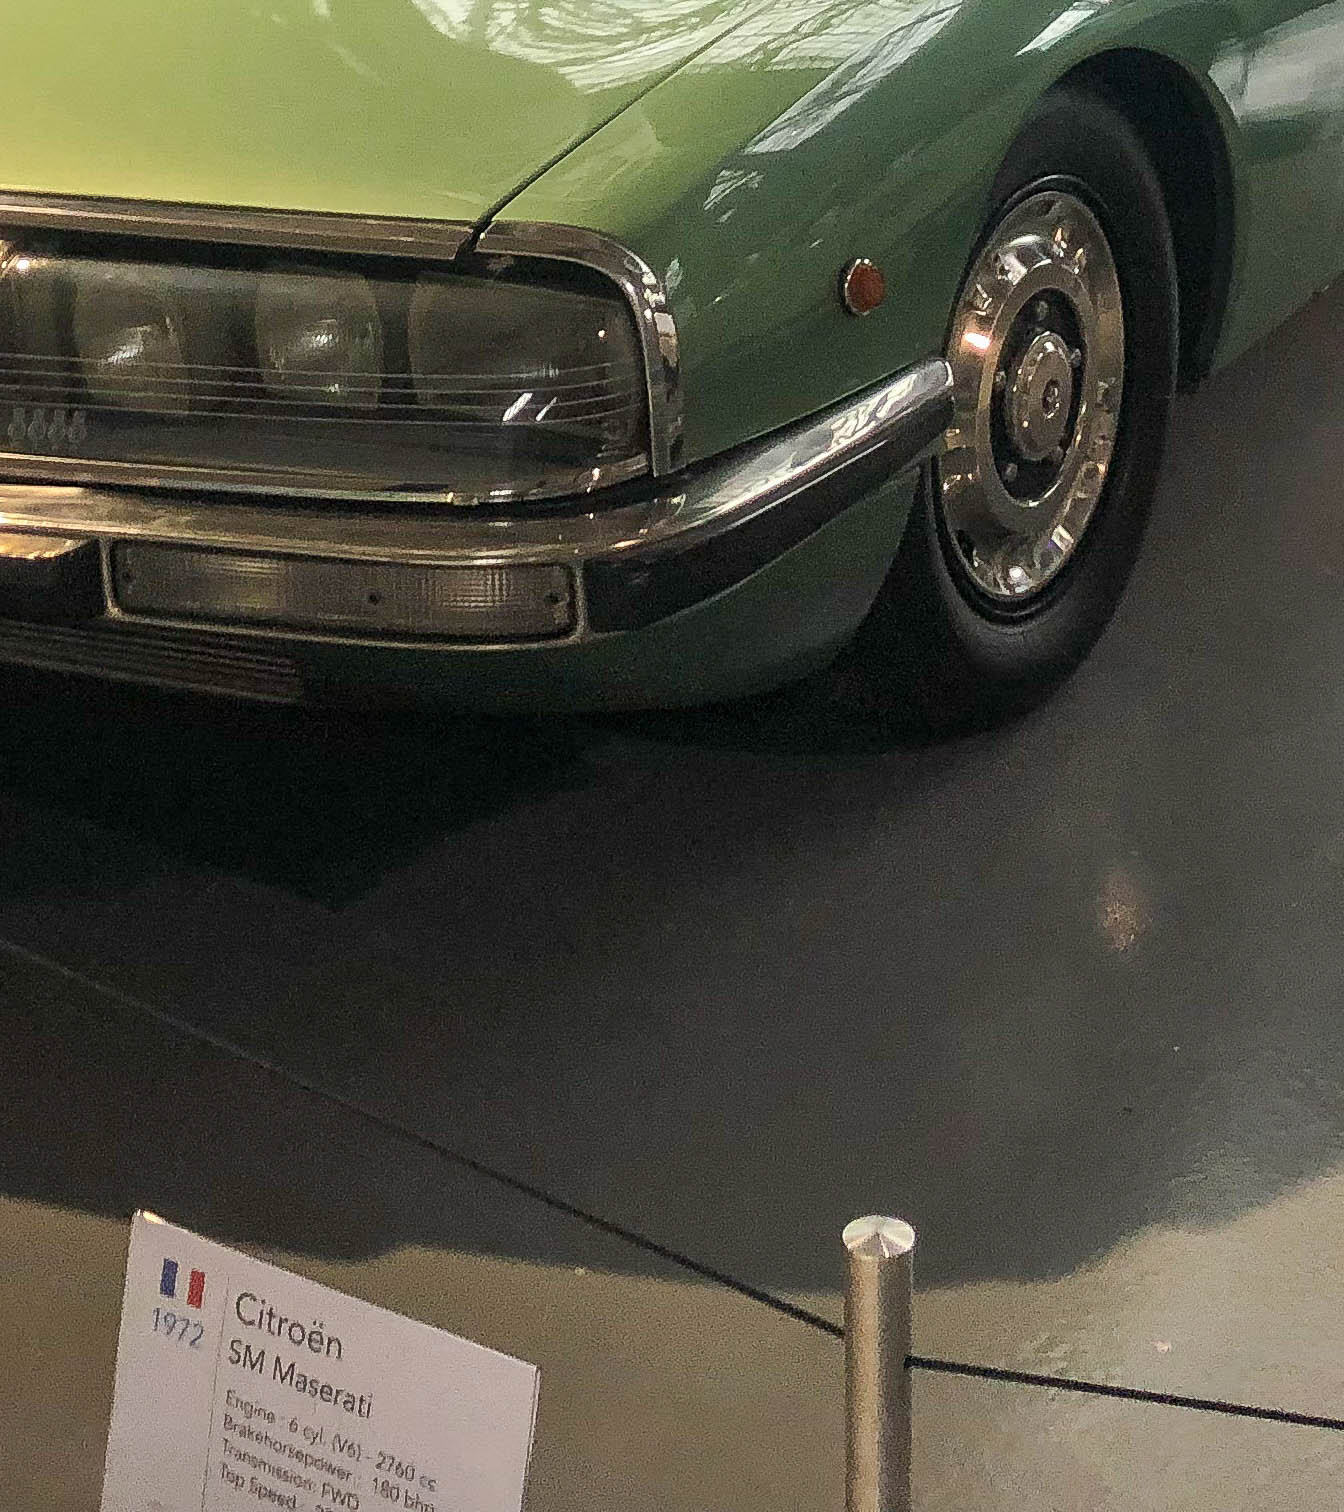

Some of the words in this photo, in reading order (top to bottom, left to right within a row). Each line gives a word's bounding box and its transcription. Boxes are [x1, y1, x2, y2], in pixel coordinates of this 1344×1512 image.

[153, 1307, 204, 1348] 1972
[235, 1291, 343, 1361] Citroën
[229, 1339, 266, 1374] SM
[272, 1355, 373, 1418] Maserati
[288, 1417, 299, 1433] 6
[332, 1433, 362, 1462] (V6)
[321, 1482, 360, 1510] FWD
[372, 1476, 400, 1503] 180
